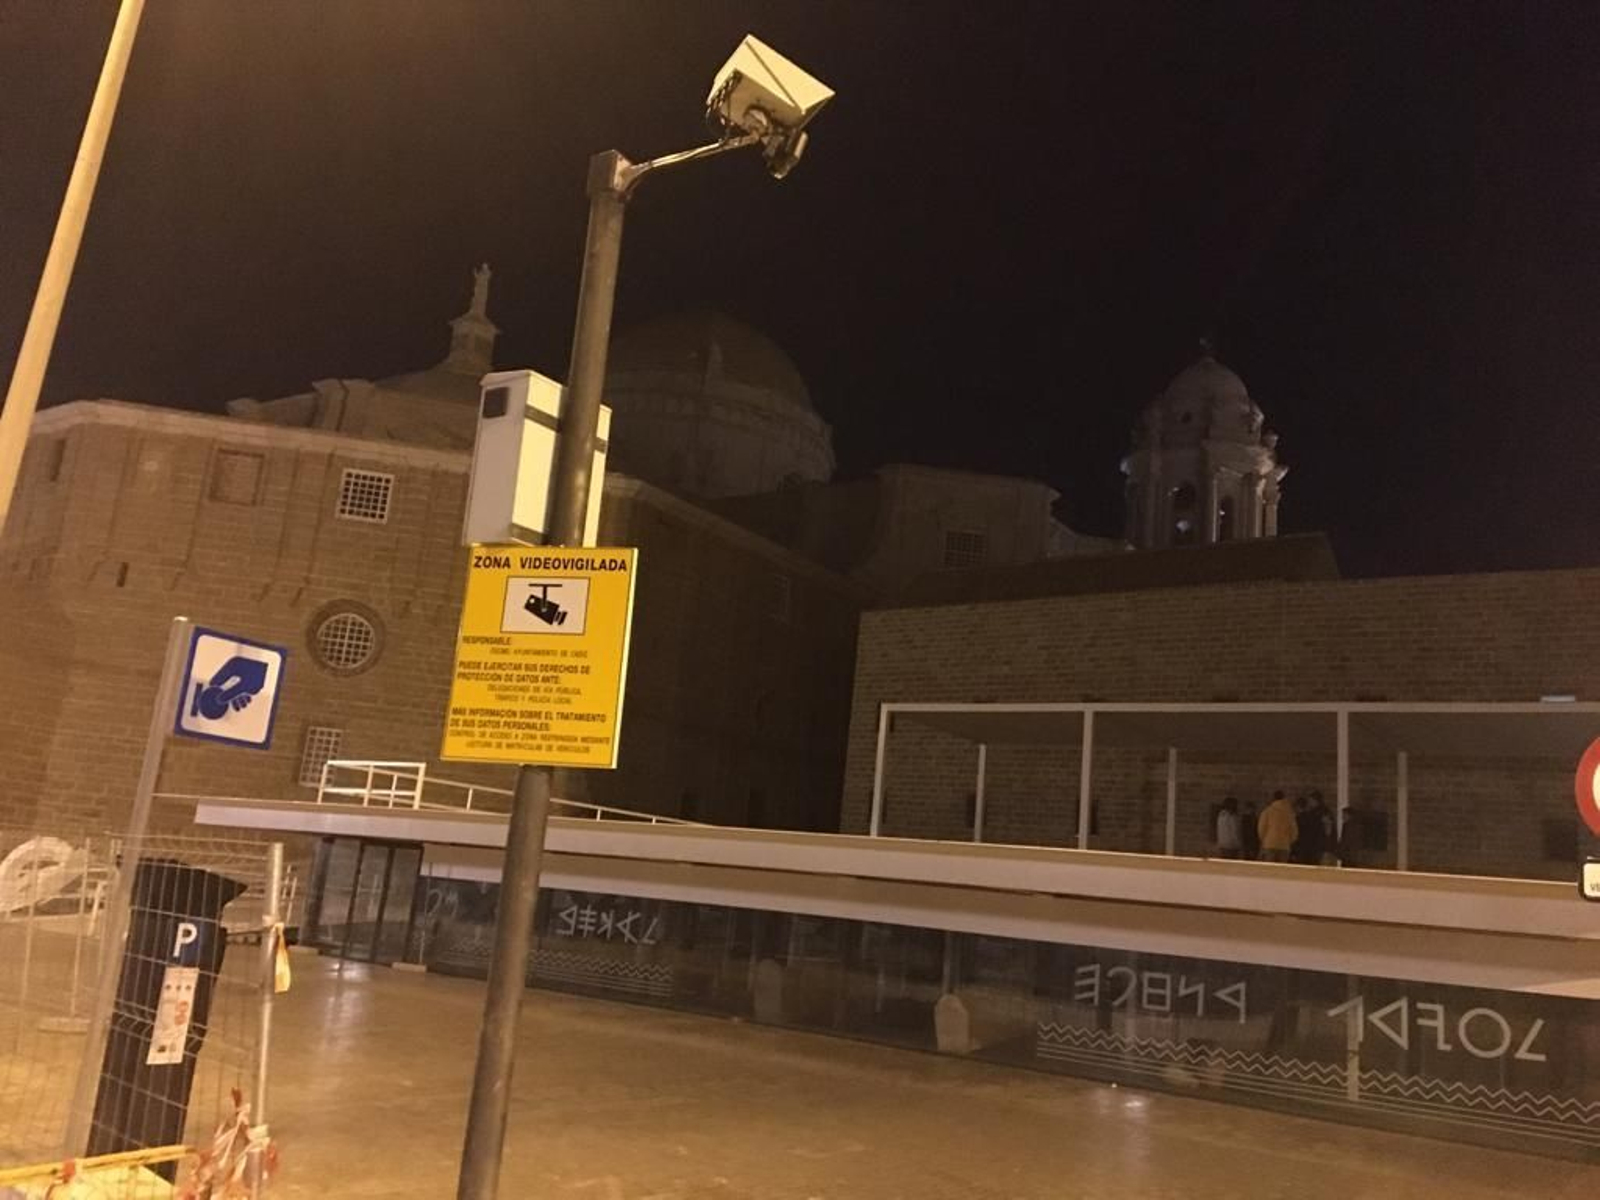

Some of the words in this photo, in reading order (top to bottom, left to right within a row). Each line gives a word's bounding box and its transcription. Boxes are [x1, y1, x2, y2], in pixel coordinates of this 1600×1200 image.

[474, 555, 511, 569] ZONA
[519, 557, 627, 571] VIDEOVIGILADA
[458, 660, 481, 670] PUEDE
[483, 661, 522, 671] EJERCITAR
[524, 663, 538, 672] SUS
[540, 663, 578, 674] DERECHOS
[580, 664, 590, 675] DE
[504, 673, 513, 682] DE
[515, 673, 540, 684] DATOS
[449, 717, 461, 727] DE
[462, 718, 475, 727] SUS
[477, 719, 501, 729] DATOS
[519, 710, 543, 720] SOBRE
[544, 711, 553, 721] EL
[556, 712, 607, 723] TRATAMIENTO
[172, 923, 198, 959] P
